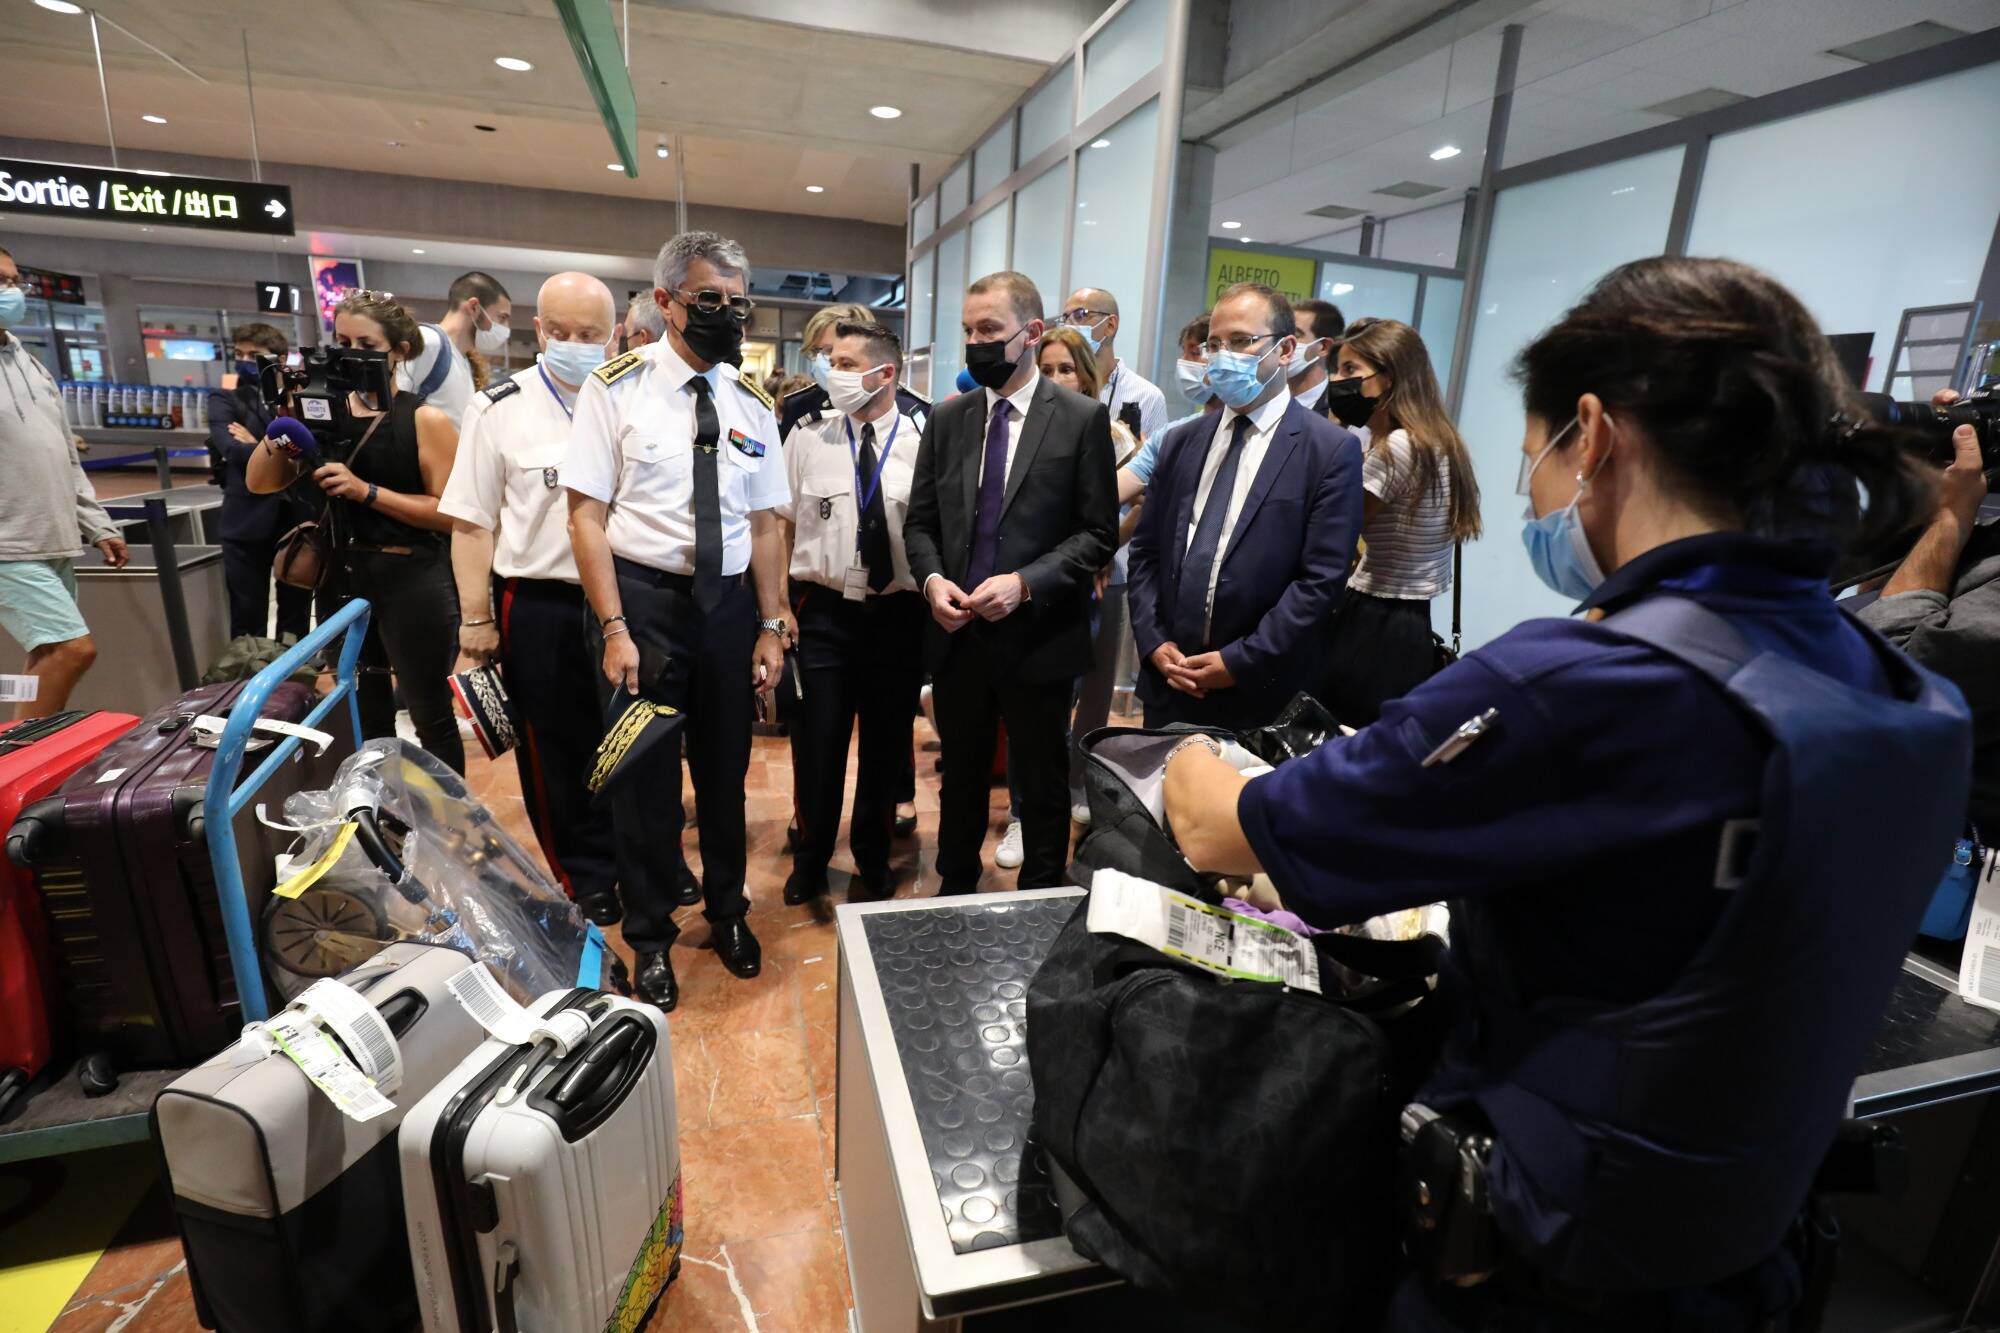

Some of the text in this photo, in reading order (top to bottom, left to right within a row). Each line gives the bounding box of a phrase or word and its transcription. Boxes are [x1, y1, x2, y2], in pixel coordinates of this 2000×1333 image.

[0, 171, 90, 208] Sortie
[1217, 263, 1280, 289] ALBERTO
[265, 286, 280, 309] 7
